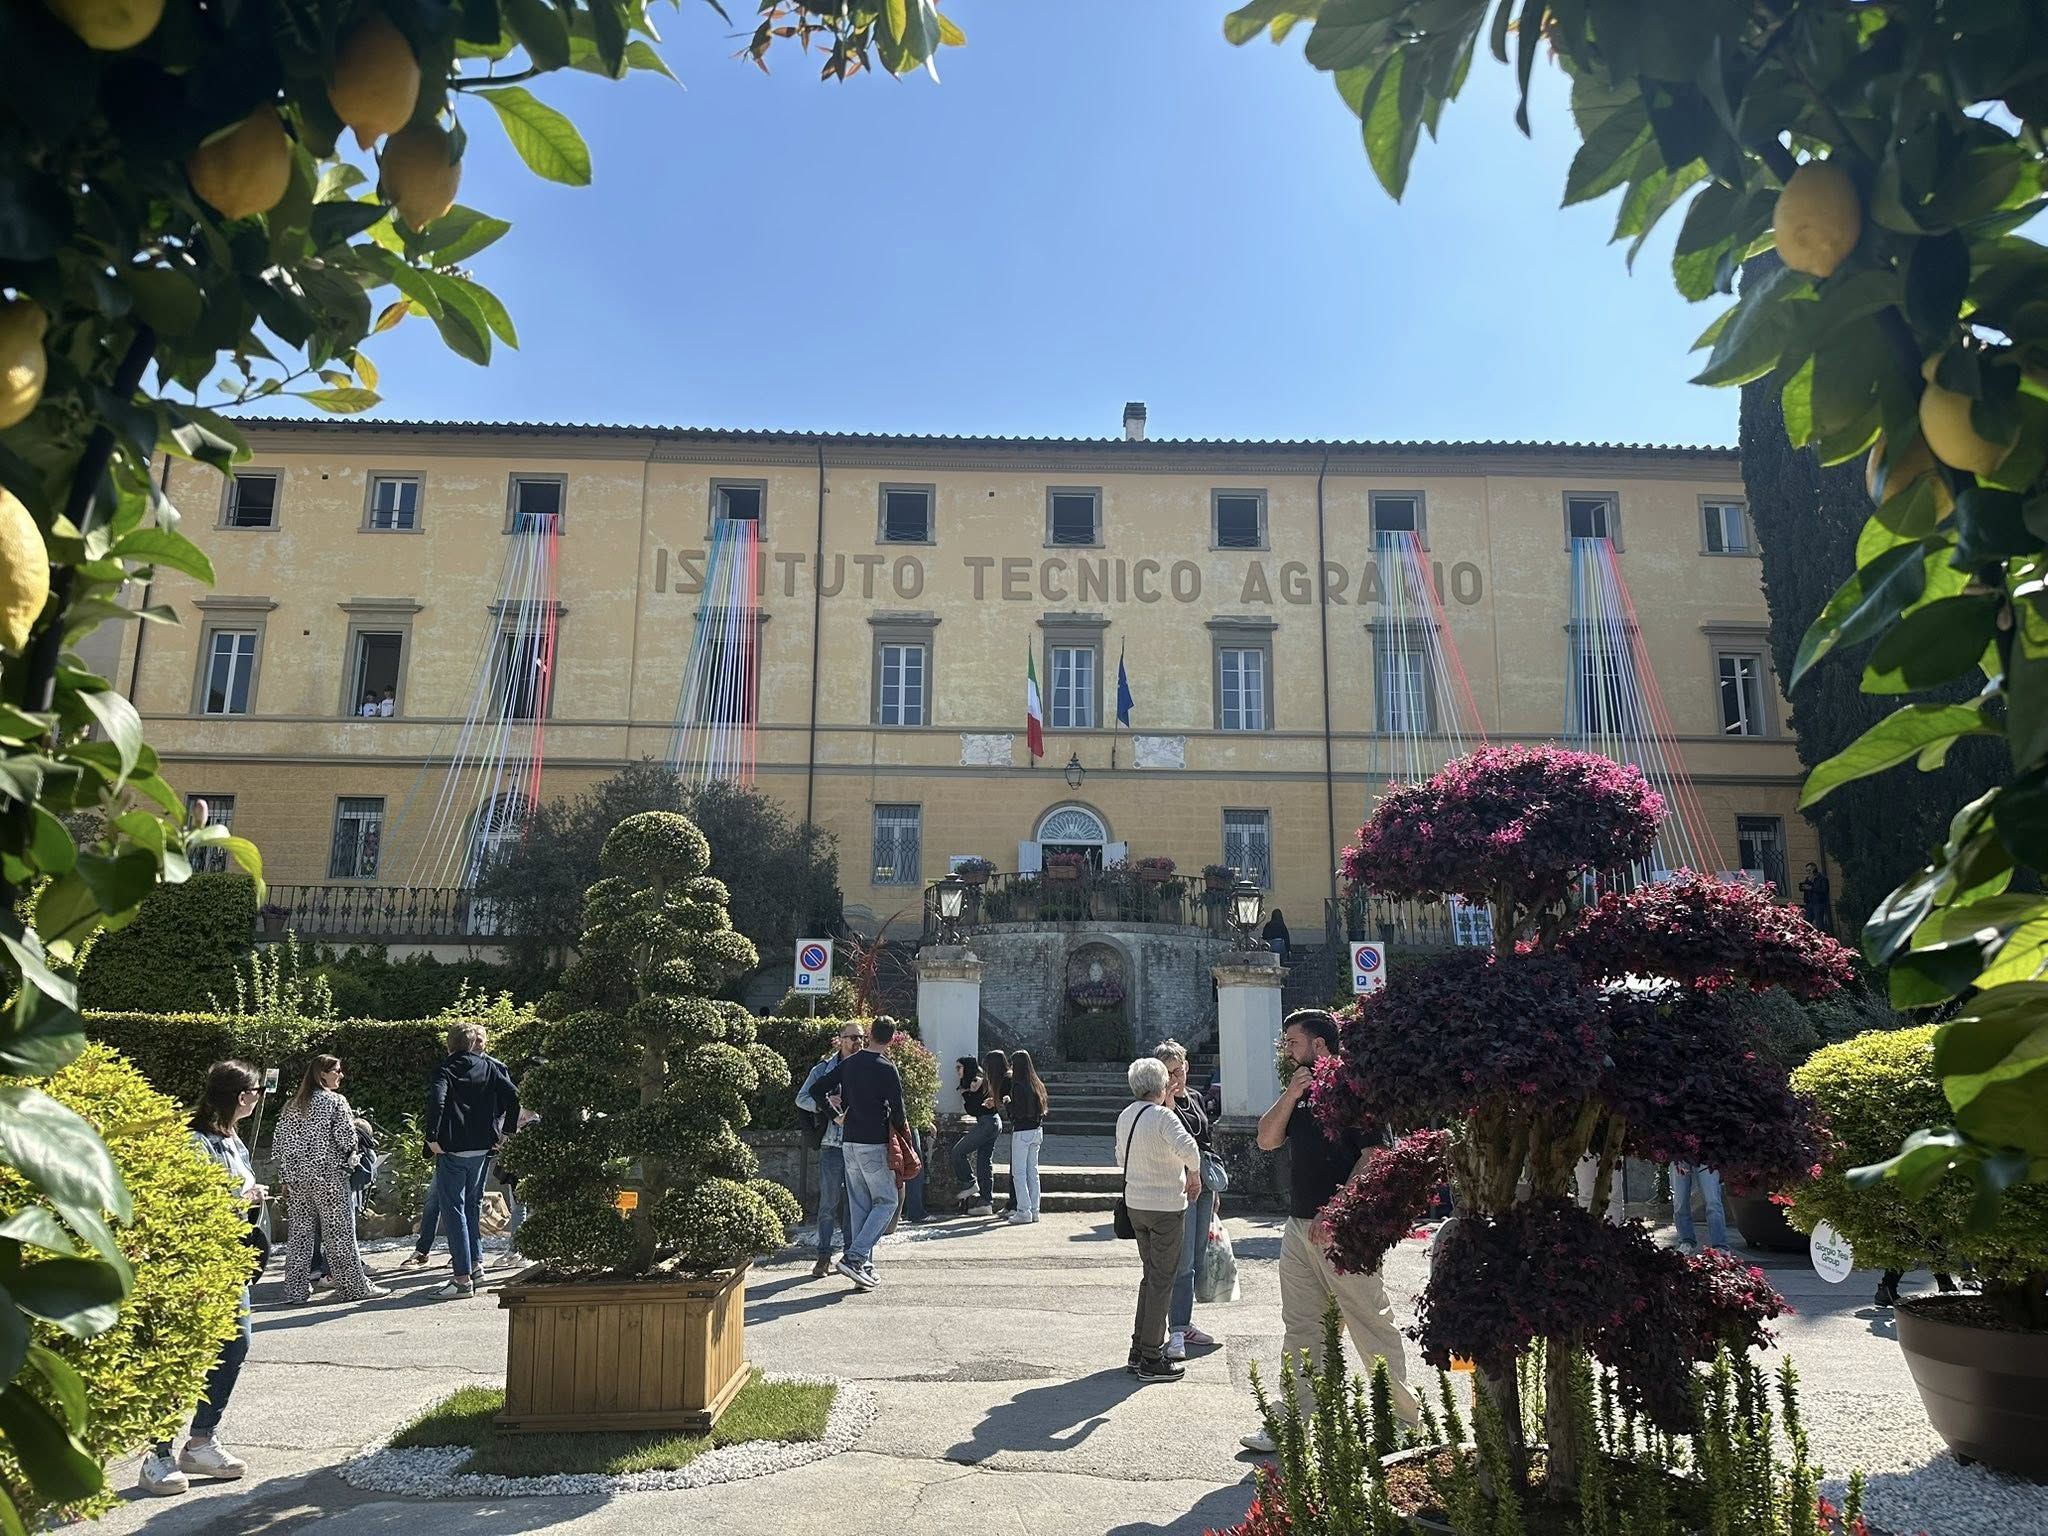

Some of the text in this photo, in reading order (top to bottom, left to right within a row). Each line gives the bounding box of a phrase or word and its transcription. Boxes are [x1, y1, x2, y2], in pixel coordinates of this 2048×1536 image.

[963, 556, 1201, 603] TECNICO
[1815, 1242, 1836, 1256] Giorgio
[1821, 1253, 1840, 1267] Group
